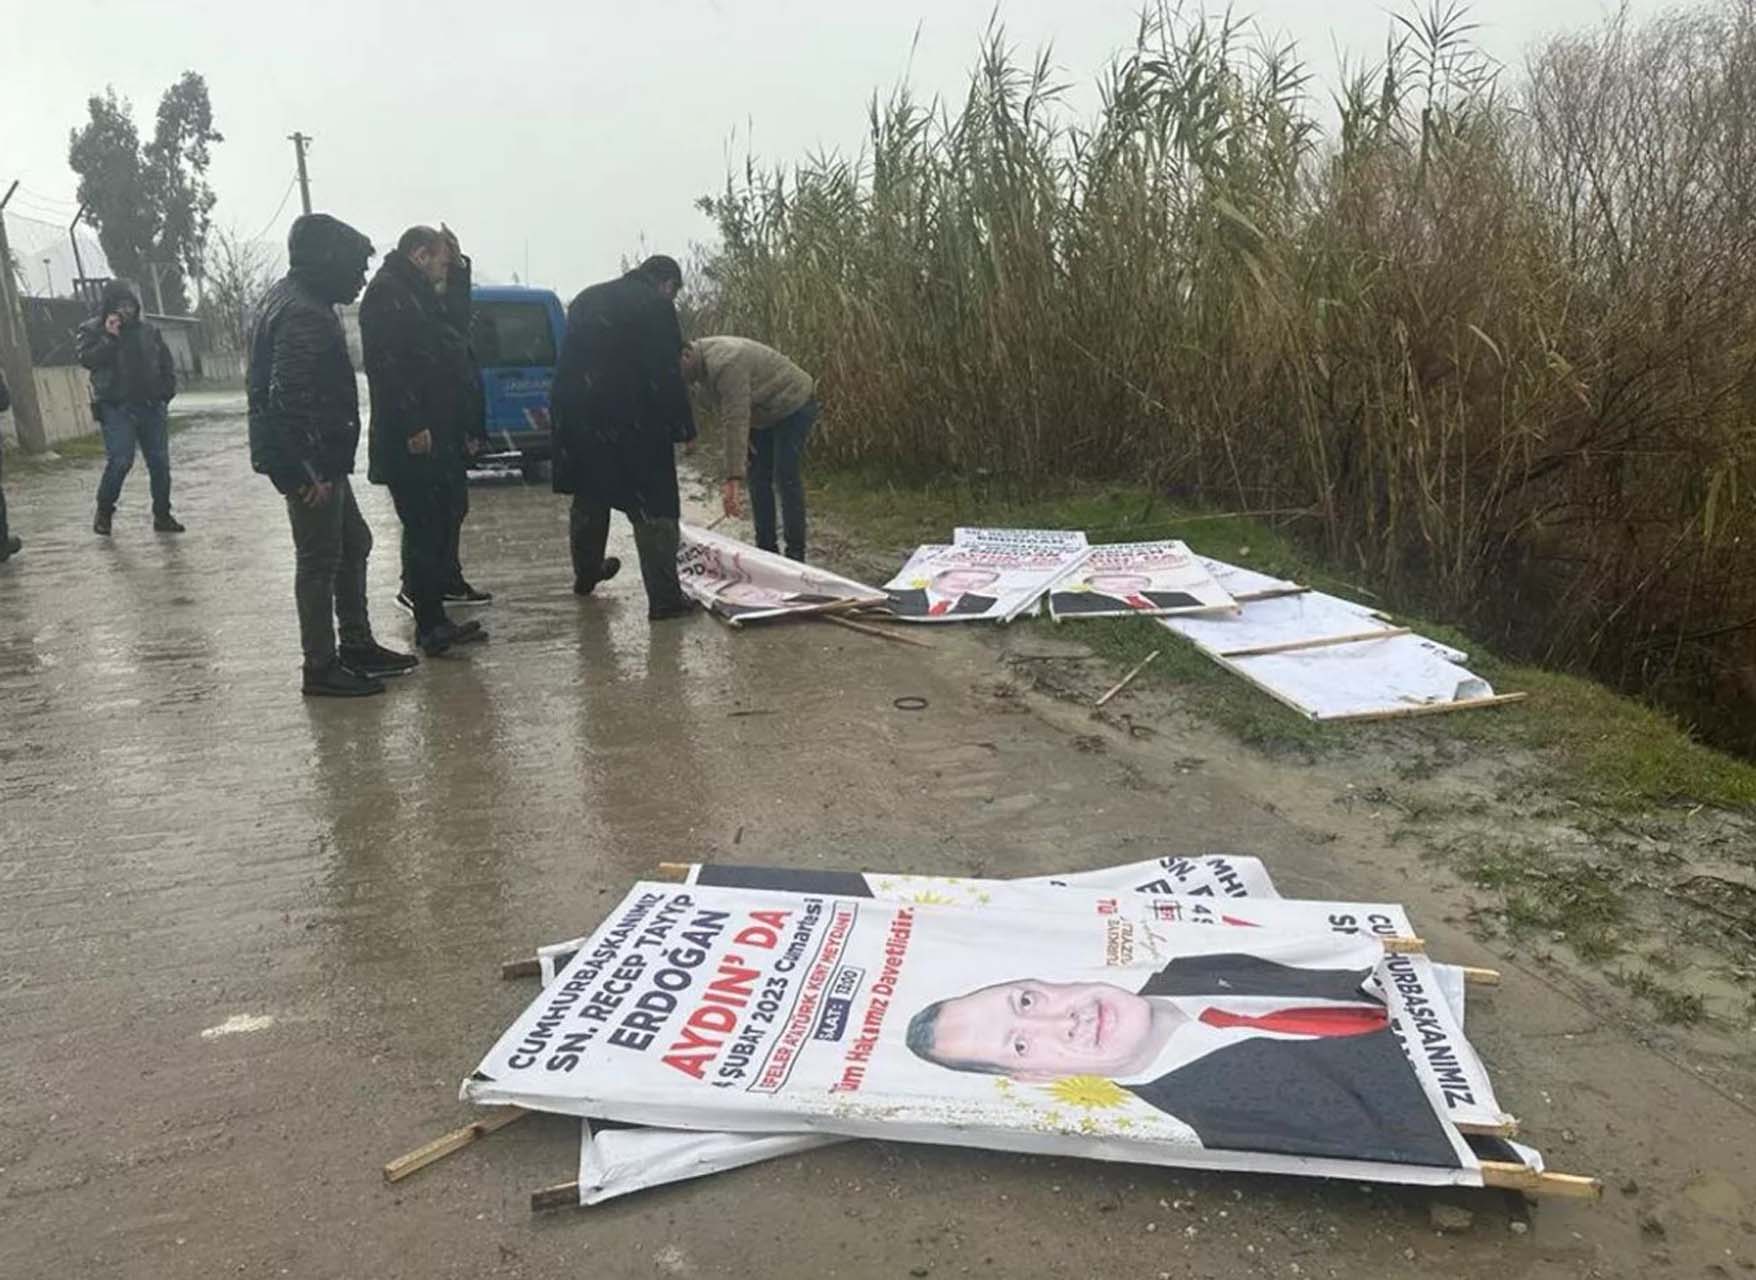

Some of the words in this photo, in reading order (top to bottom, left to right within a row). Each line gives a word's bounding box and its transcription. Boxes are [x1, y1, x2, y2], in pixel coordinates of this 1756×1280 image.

[508, 892, 666, 1070] CUMHURBAŞKANIMIZ
[607, 909, 731, 1051] ERDOĞAN
[718, 1025, 767, 1080] ŞUBAT
[752, 975, 789, 1024] 2023
[774, 897, 824, 973] Cumartesi
[733, 911, 793, 950] DA
[824, 911, 853, 961] MEYDANI
[871, 906, 915, 997] Davetlidir.
[545, 1027, 598, 1073] SN.
[578, 953, 648, 1023] RECEP
